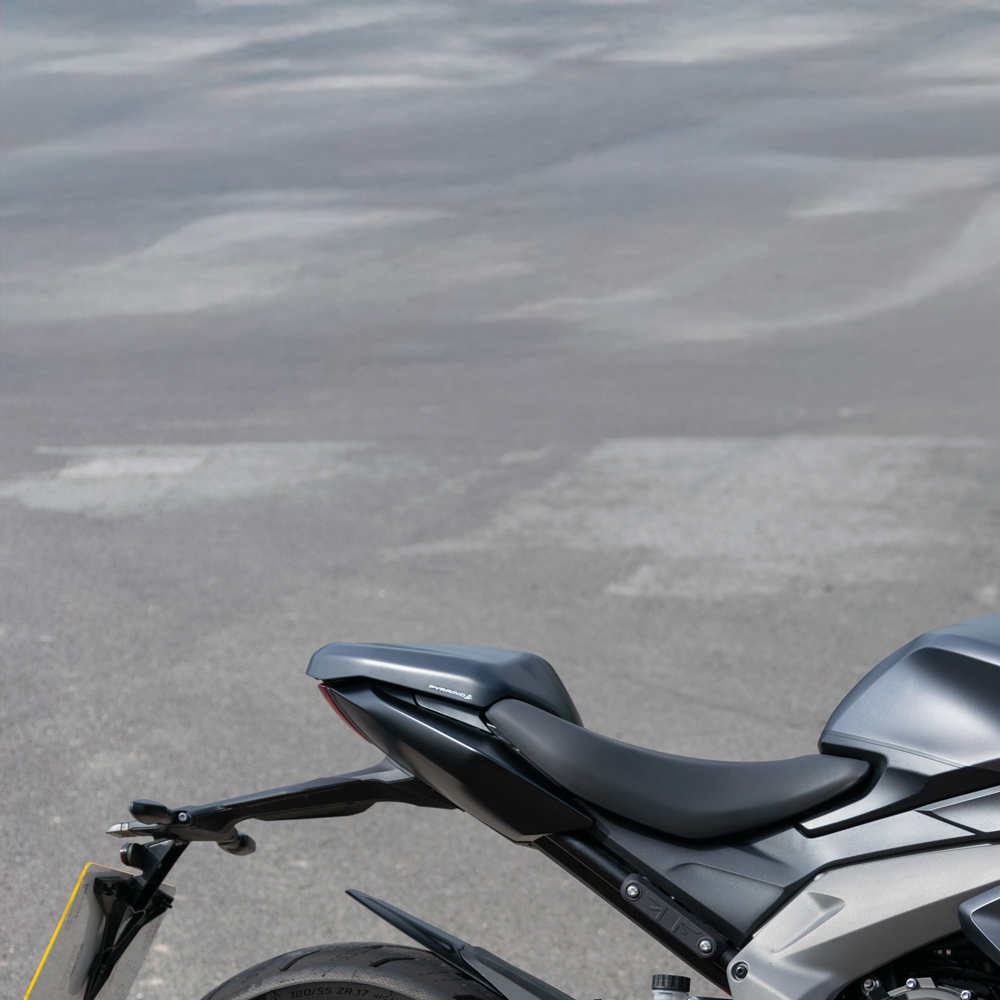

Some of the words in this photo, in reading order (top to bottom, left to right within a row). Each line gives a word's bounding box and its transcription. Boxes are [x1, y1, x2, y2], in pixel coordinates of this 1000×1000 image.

[290, 986, 332, 999] 180/55
[336, 986, 353, 997] ZR
[356, 988, 370, 998] 17
